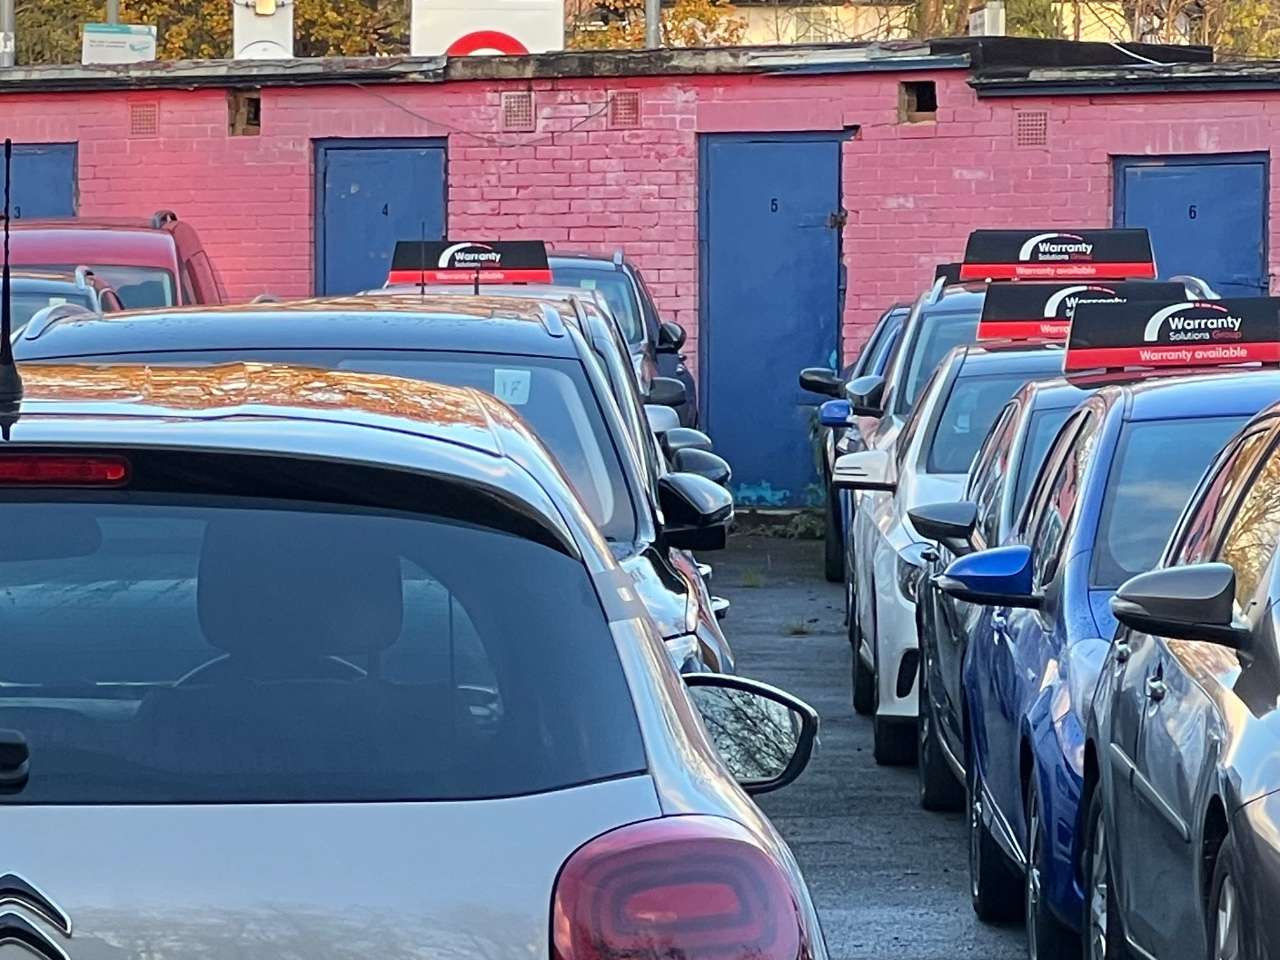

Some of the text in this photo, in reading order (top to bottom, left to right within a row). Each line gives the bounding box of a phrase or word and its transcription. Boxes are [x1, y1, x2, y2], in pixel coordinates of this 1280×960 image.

[14, 206, 21, 219] 3
[381, 203, 388, 216] 4
[1189, 204, 1197, 219] 6
[1038, 242, 1093, 255] Warranty
[454, 252, 501, 263] Warranty
[1169, 316, 1242, 331] Warranty
[1169, 329, 1242, 341] Solutions Group
[1140, 346, 1247, 362] Warranty available
